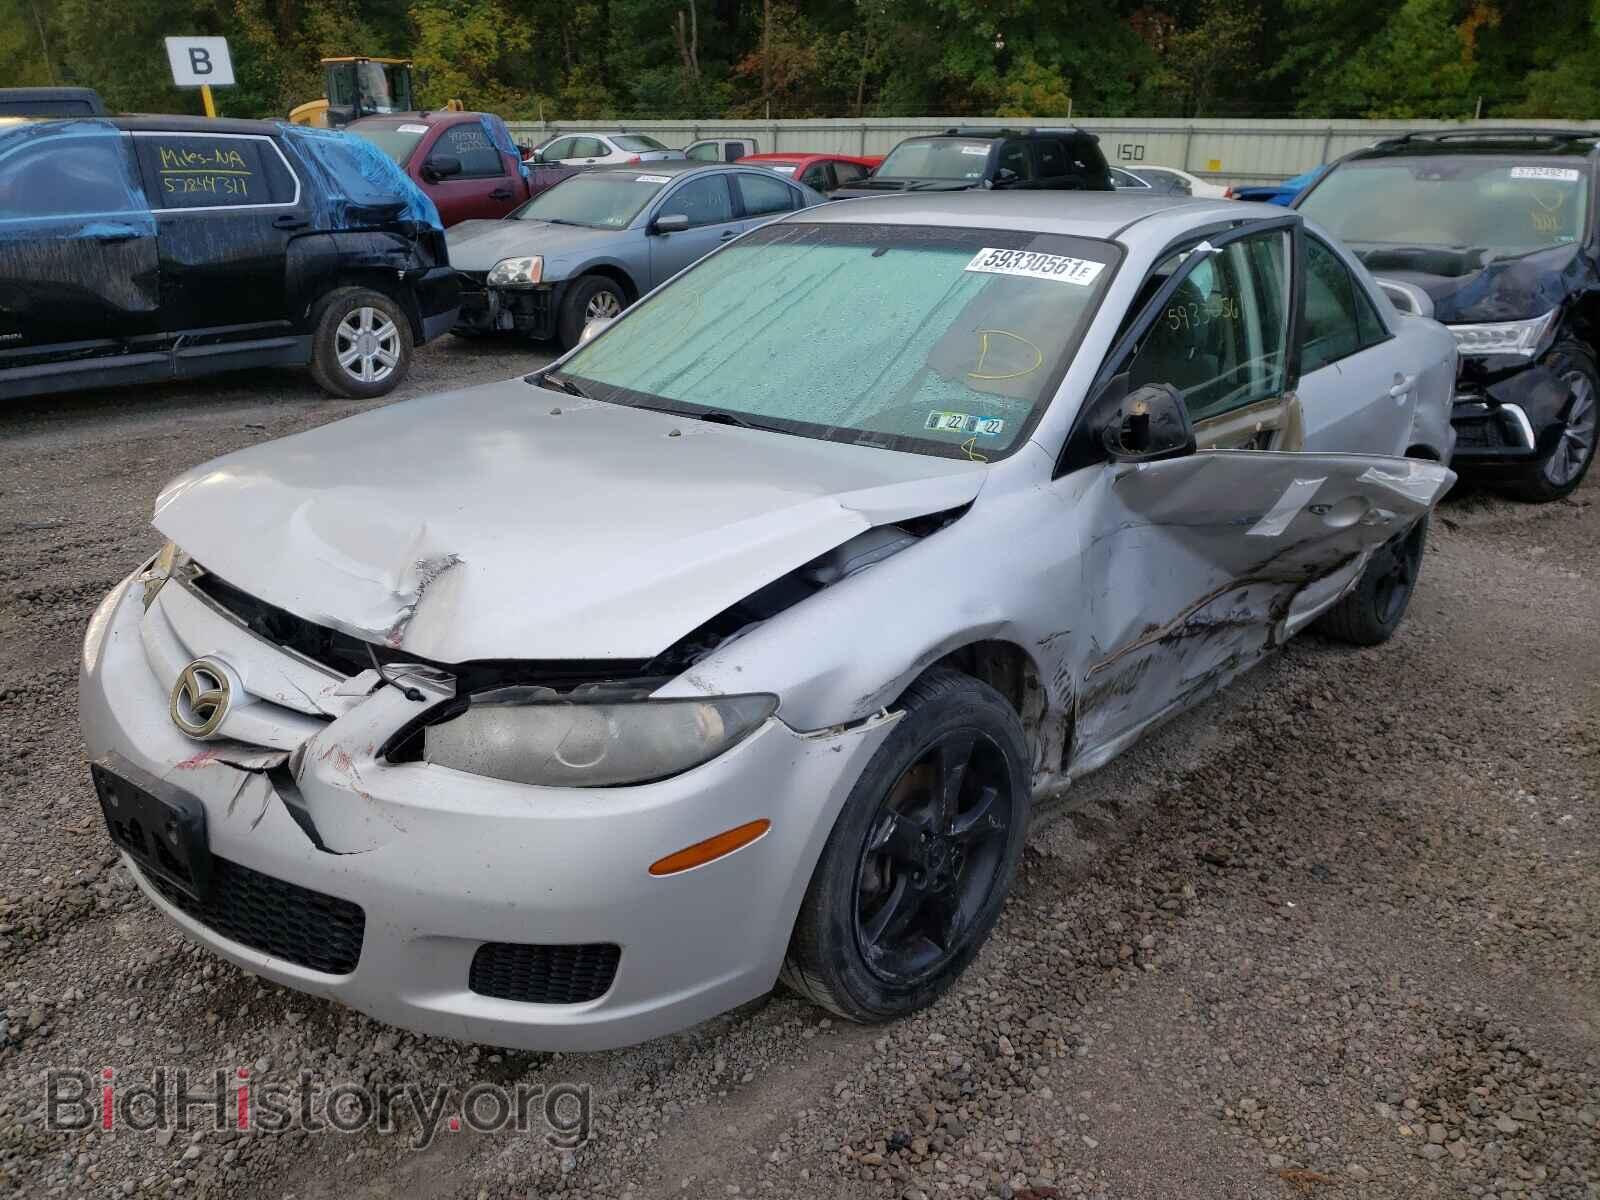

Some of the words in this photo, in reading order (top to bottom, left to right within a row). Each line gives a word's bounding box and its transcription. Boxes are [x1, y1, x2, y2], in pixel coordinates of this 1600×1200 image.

[188, 47, 213, 75] B
[1117, 144, 1145, 160] 150
[983, 249, 1083, 277] 59330561
[968, 329, 1042, 379] D
[948, 415, 962, 429] 22
[984, 420, 1000, 434] 22
